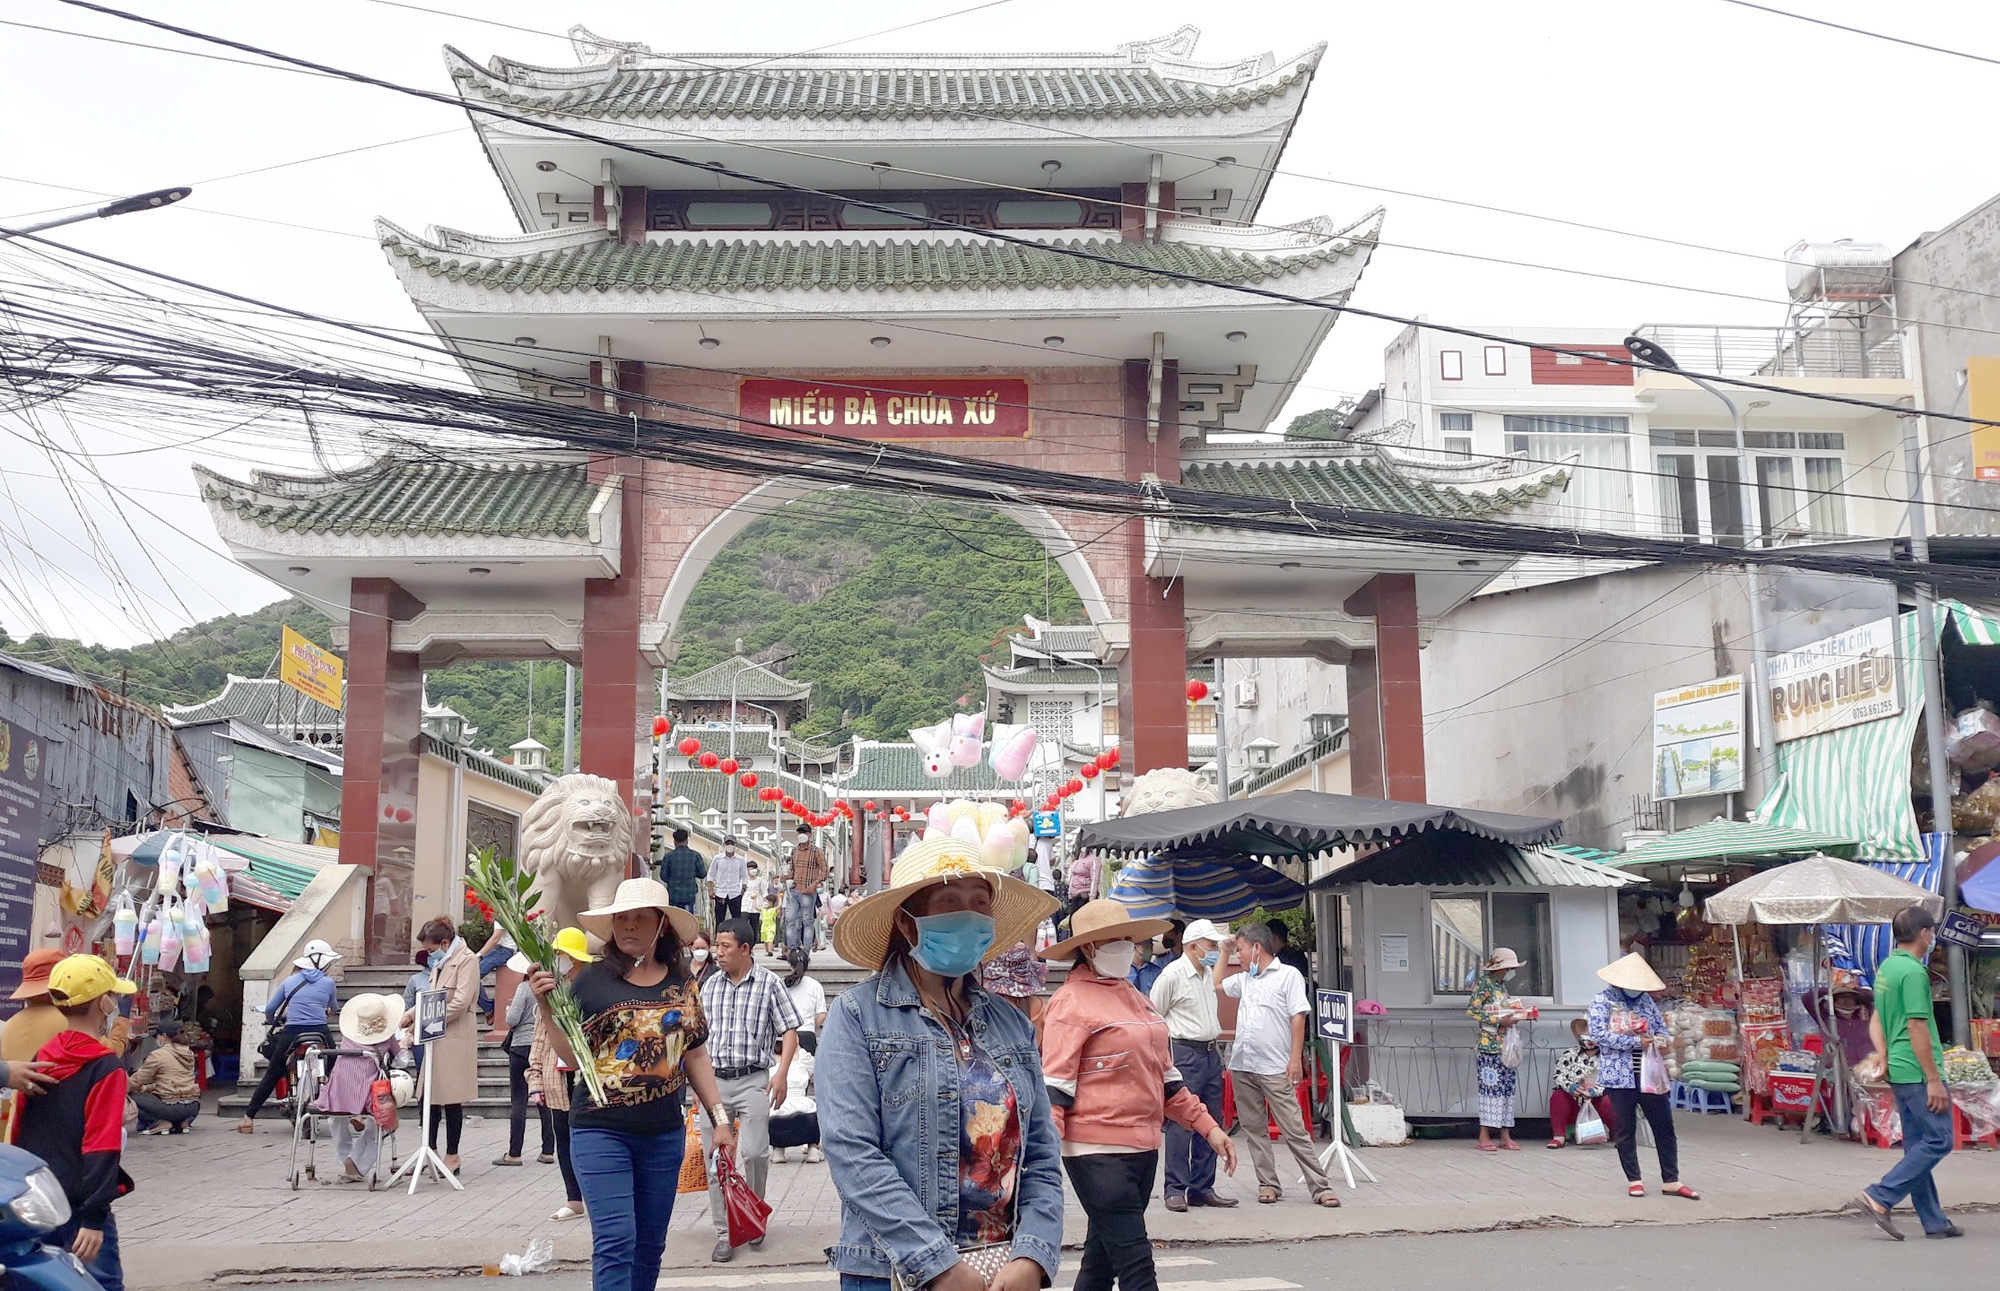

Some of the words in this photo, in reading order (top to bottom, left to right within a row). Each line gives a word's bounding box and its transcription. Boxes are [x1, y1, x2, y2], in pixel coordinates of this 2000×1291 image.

[769, 389, 834, 425] MIẾU
[844, 391, 878, 425] BÀ
[887, 390, 953, 425] CHÚA
[962, 390, 999, 425] XỨ
[1772, 672, 1834, 722] RUNG
[1836, 647, 1893, 705] HIẾU
[1852, 700, 1892, 719] 0763.861255
[422, 995, 435, 1020] LỐI
[435, 1000, 446, 1018] RA
[1319, 995, 1331, 1018] LỐI
[1331, 997, 1346, 1021] VÀO
